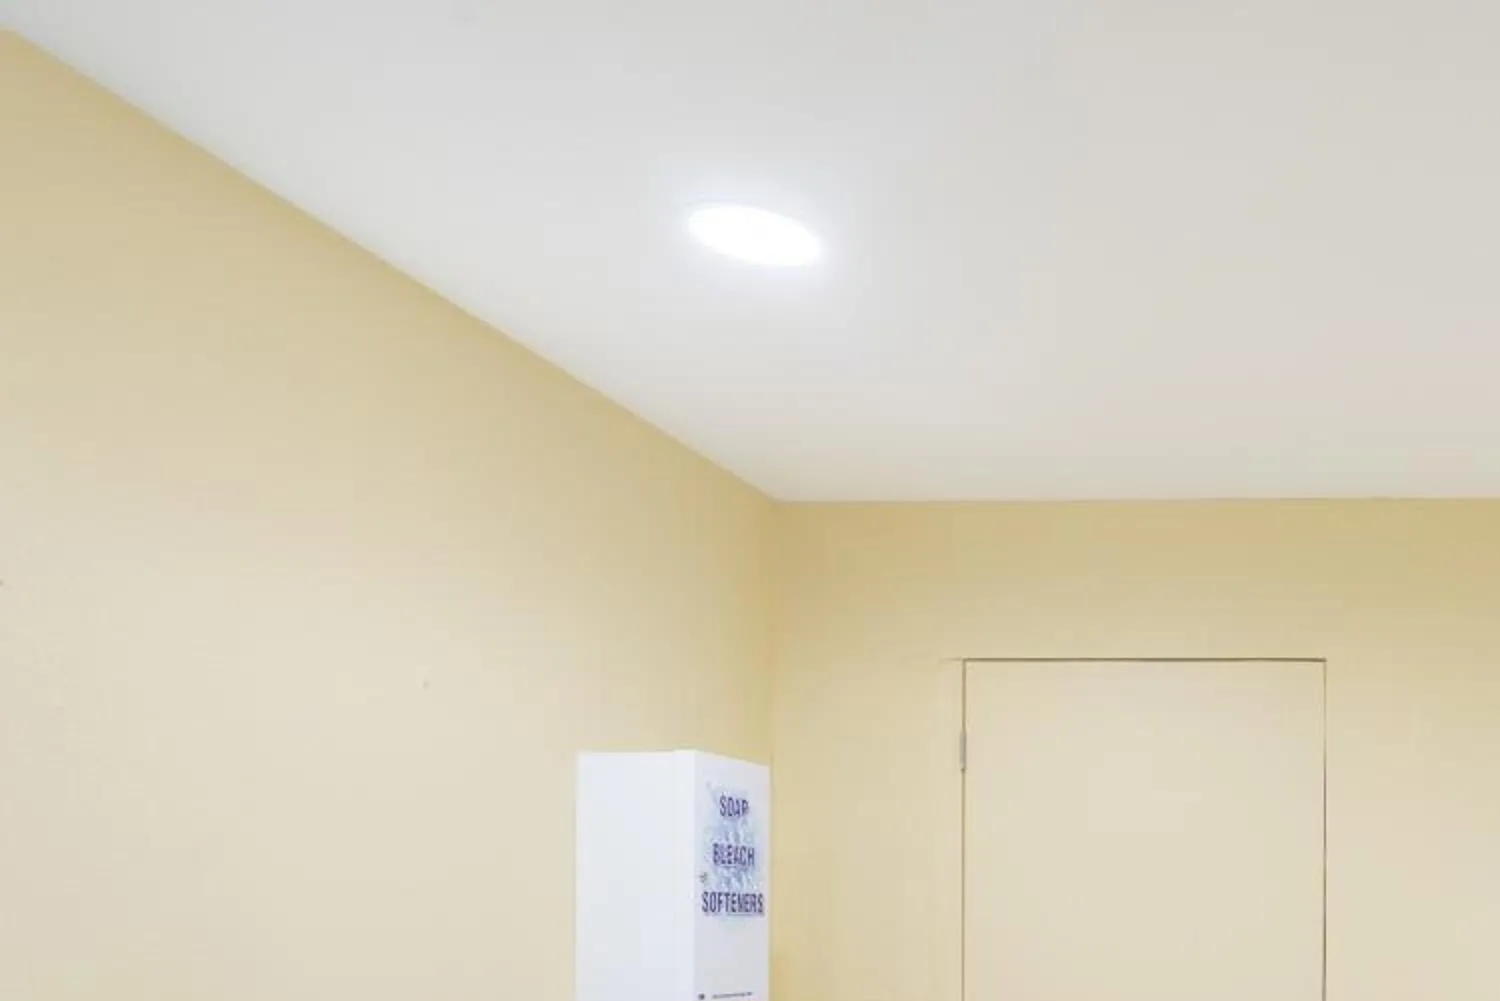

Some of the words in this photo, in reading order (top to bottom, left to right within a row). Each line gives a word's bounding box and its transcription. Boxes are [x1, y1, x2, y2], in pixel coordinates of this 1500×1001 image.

[719, 795, 749, 817] SOAP
[712, 842, 755, 867] BLEACH
[701, 891, 764, 914] SOFTENERS
